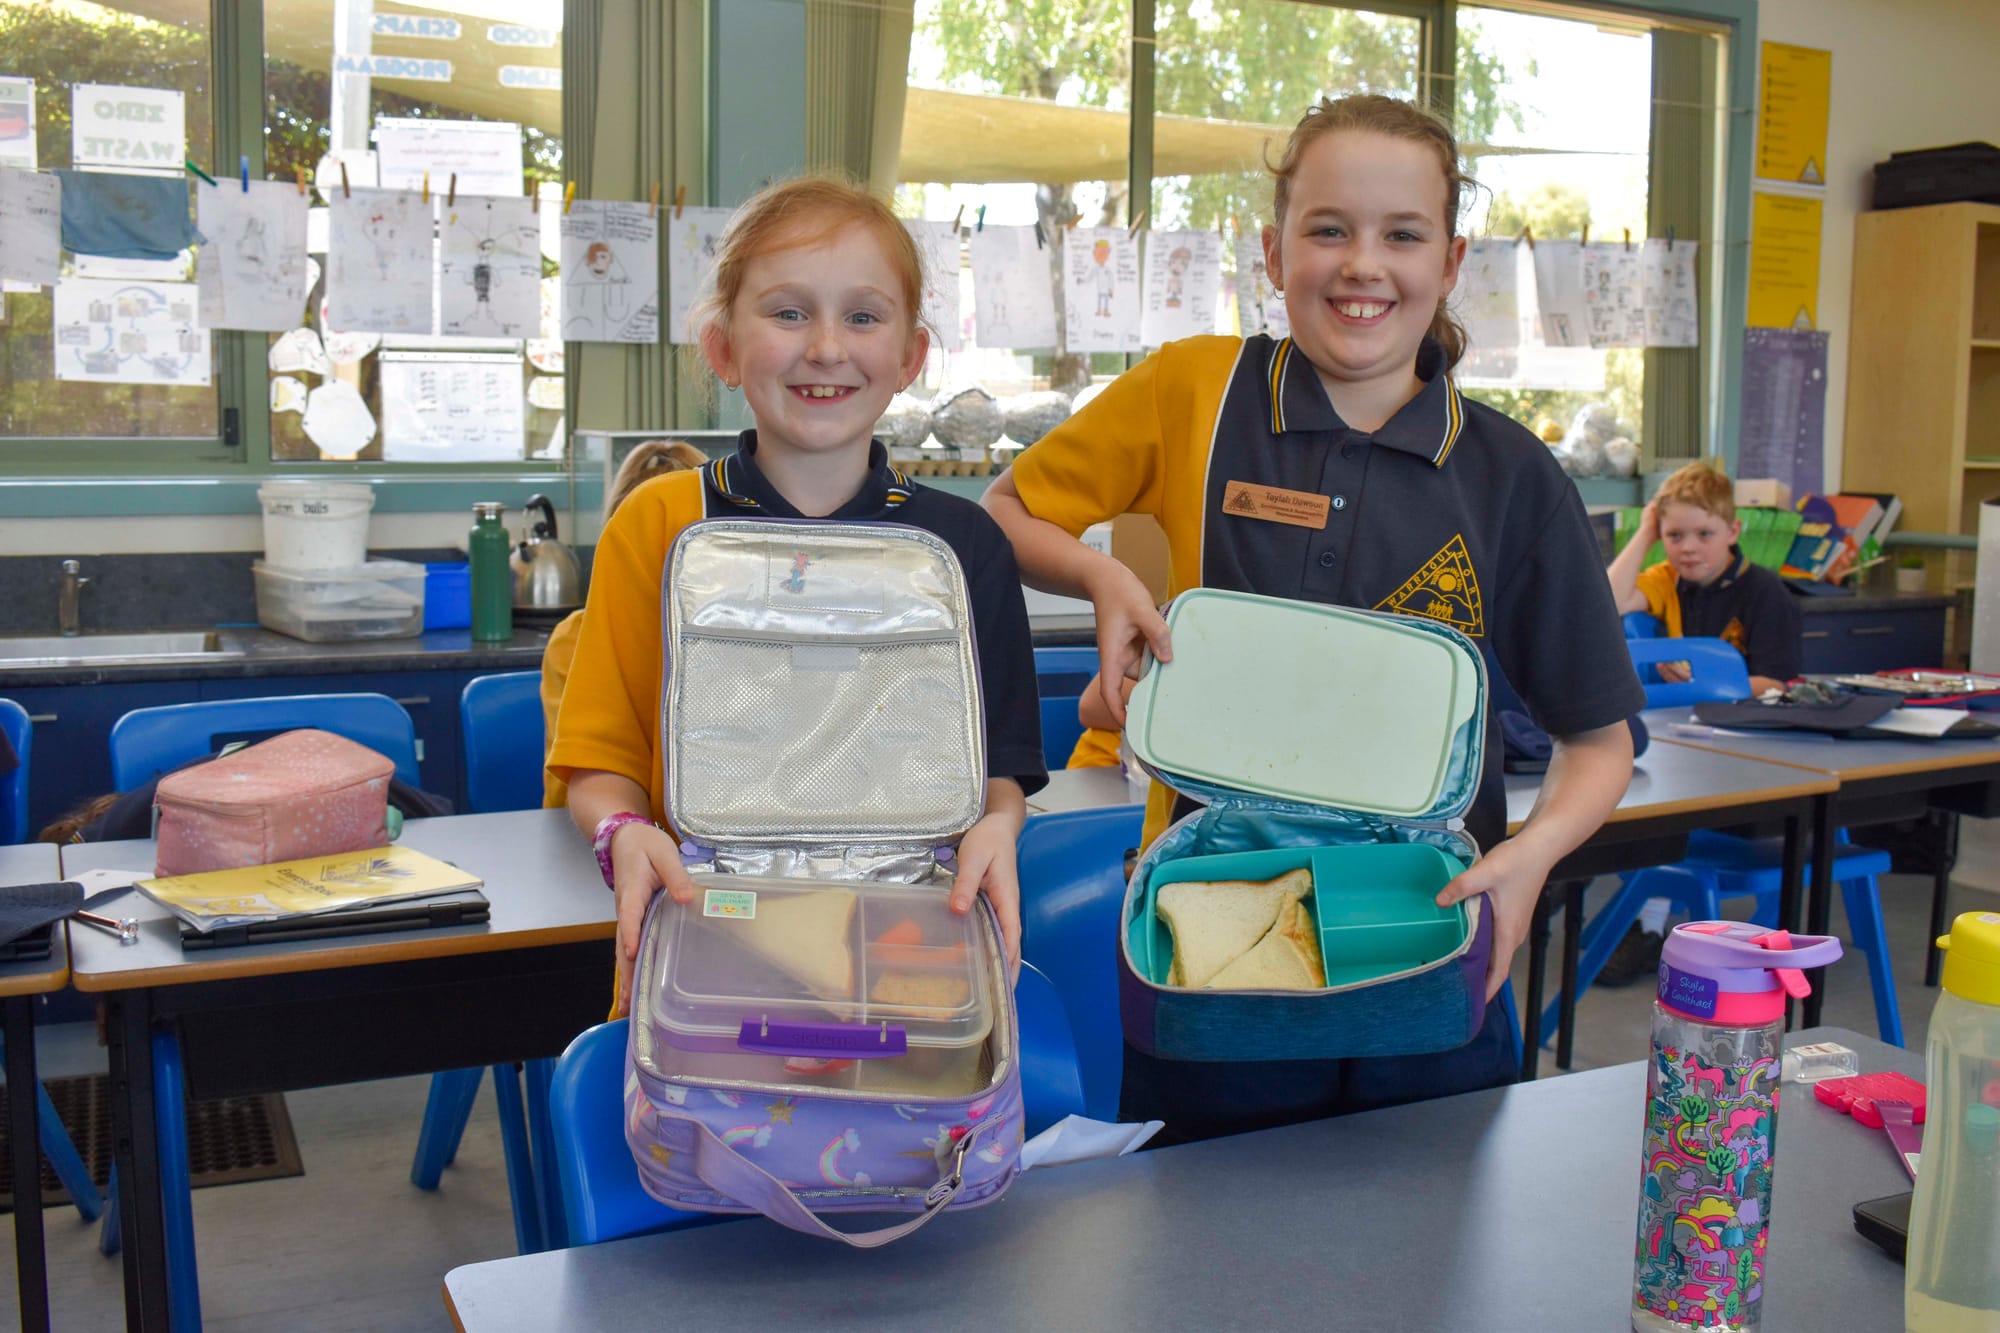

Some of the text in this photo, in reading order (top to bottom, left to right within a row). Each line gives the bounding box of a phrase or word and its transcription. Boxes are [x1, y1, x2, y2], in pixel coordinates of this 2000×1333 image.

[1679, 976, 1705, 993] Skyla
[1671, 989, 1713, 1010] Coulthard
[791, 1031, 857, 1048] sistema
